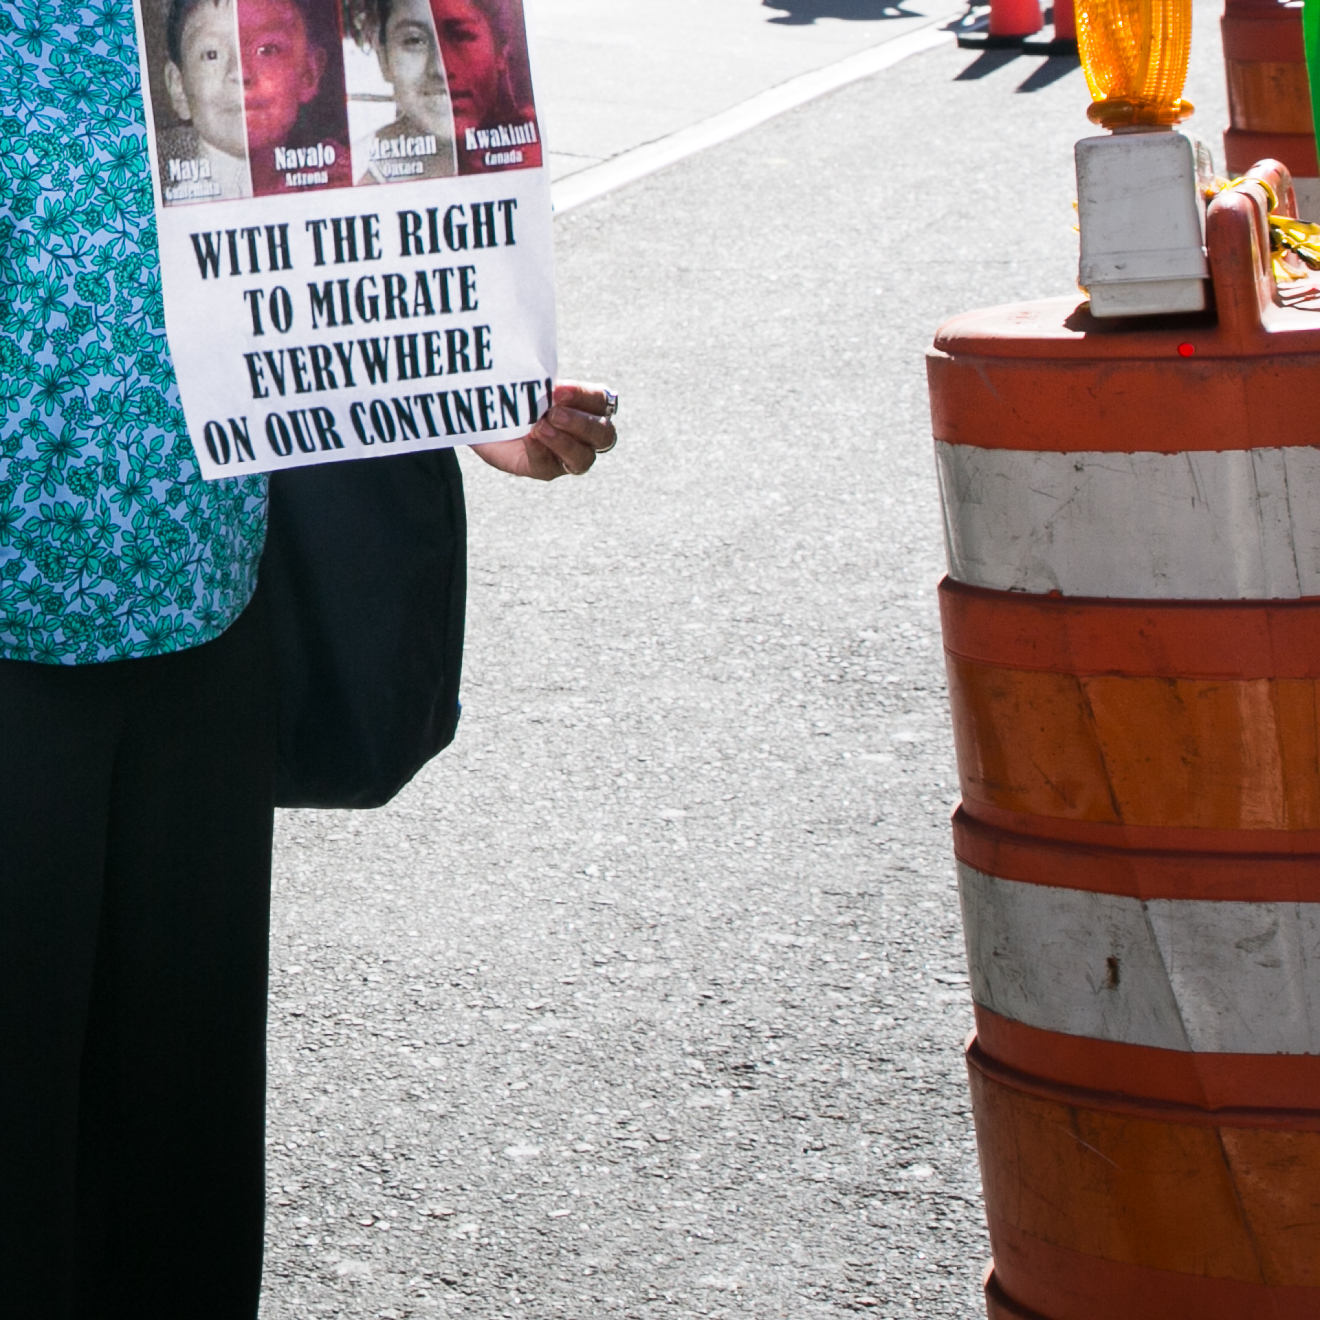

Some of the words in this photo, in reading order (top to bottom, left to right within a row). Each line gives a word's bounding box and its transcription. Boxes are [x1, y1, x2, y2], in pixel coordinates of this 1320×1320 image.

[168, 158, 212, 183] Maya
[274, 143, 336, 171] Navajo
[190, 222, 294, 280] WITH
[305, 212, 383, 267] THE
[396, 197, 518, 258] RIGHT
[243, 285, 294, 336] TO
[306, 264, 479, 330] MIGRATE
[243, 323, 494, 400] EVERYWHERE
[203, 415, 257, 466] ON
[265, 405, 345, 457] OUR
